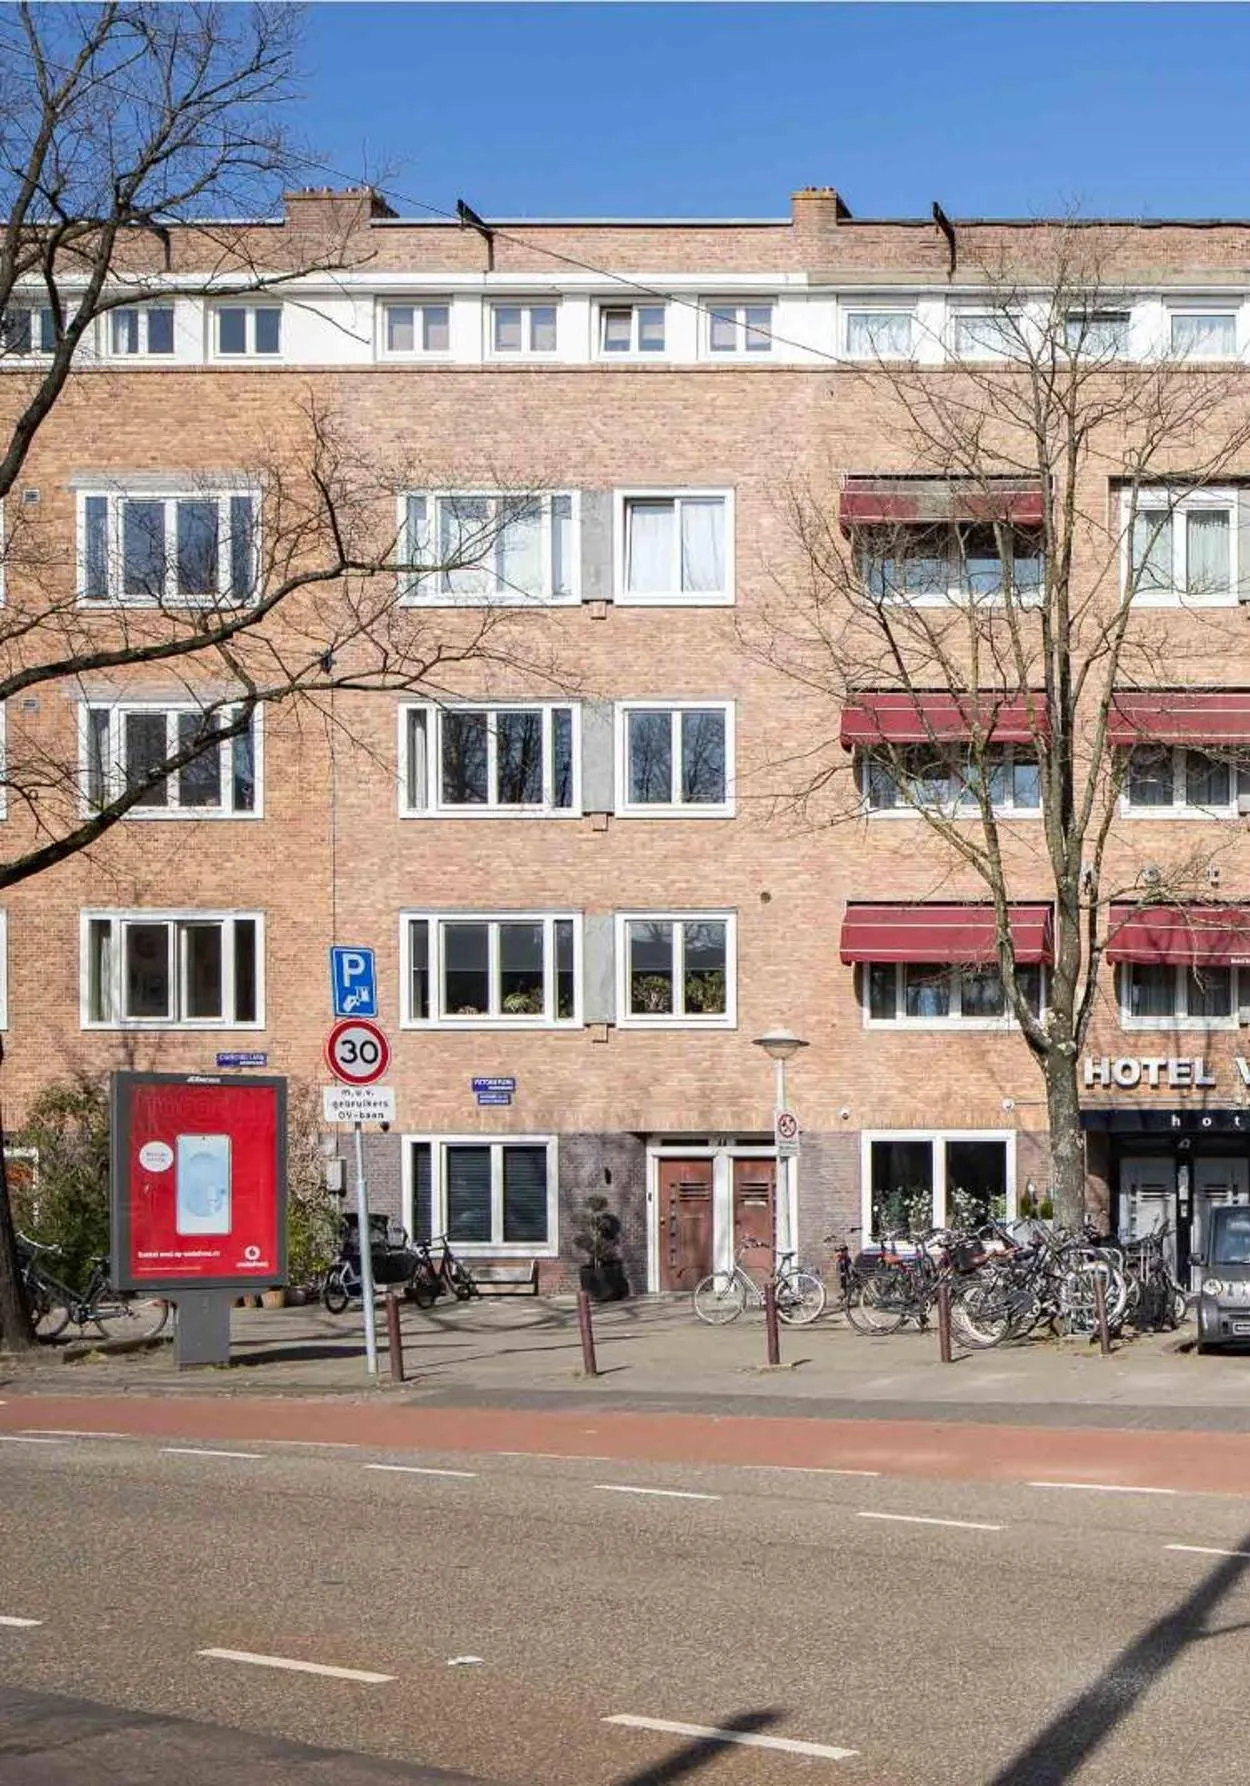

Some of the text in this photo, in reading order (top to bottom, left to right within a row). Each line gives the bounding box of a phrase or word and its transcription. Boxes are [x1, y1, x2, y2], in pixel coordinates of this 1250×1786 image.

[342, 953, 366, 988] P
[340, 1039, 379, 1065] 30
[1083, 1056, 1216, 1087] HOTEL
[332, 1100, 389, 1109] gebruikers
[338, 1111, 384, 1120] OV-baan
